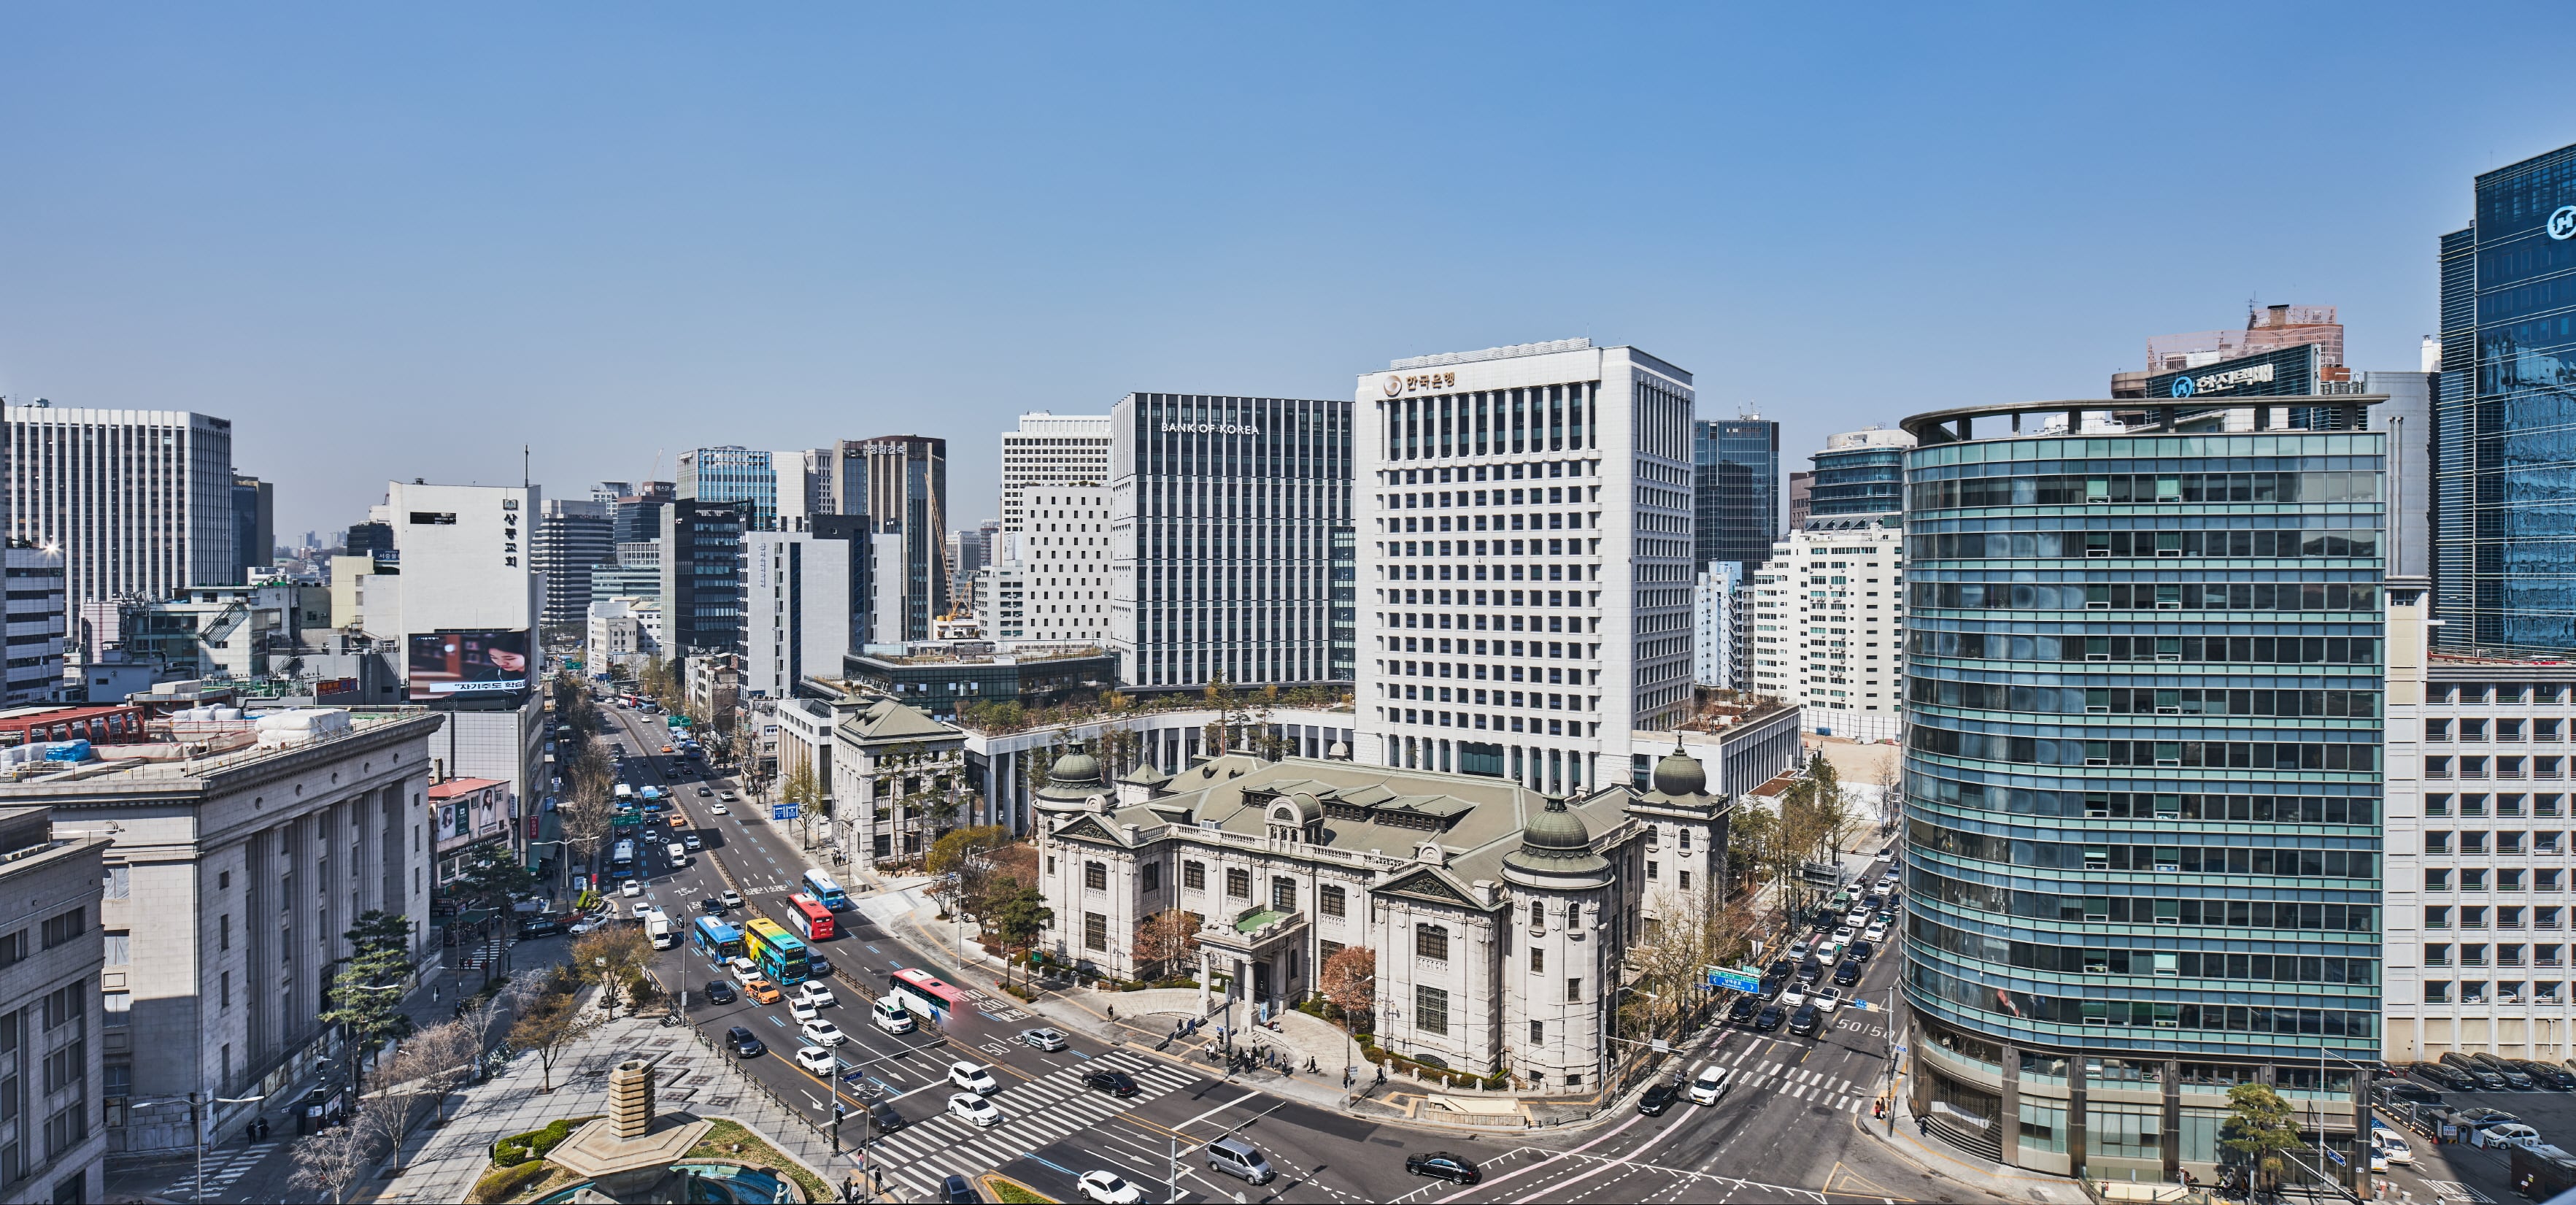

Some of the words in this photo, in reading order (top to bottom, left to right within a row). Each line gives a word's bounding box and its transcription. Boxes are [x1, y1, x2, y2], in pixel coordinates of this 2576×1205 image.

[1405, 371, 1455, 392] 한국은행
[2195, 363, 2273, 393] 한진택배
[1161, 423, 1196, 433] BANK
[1199, 424, 1215, 434] OF
[1219, 425, 1260, 435] KOREA
[504, 513, 517, 568] 상동교회
[1836, 1019, 1862, 1032] 50
[979, 1042, 1011, 1056] 50
